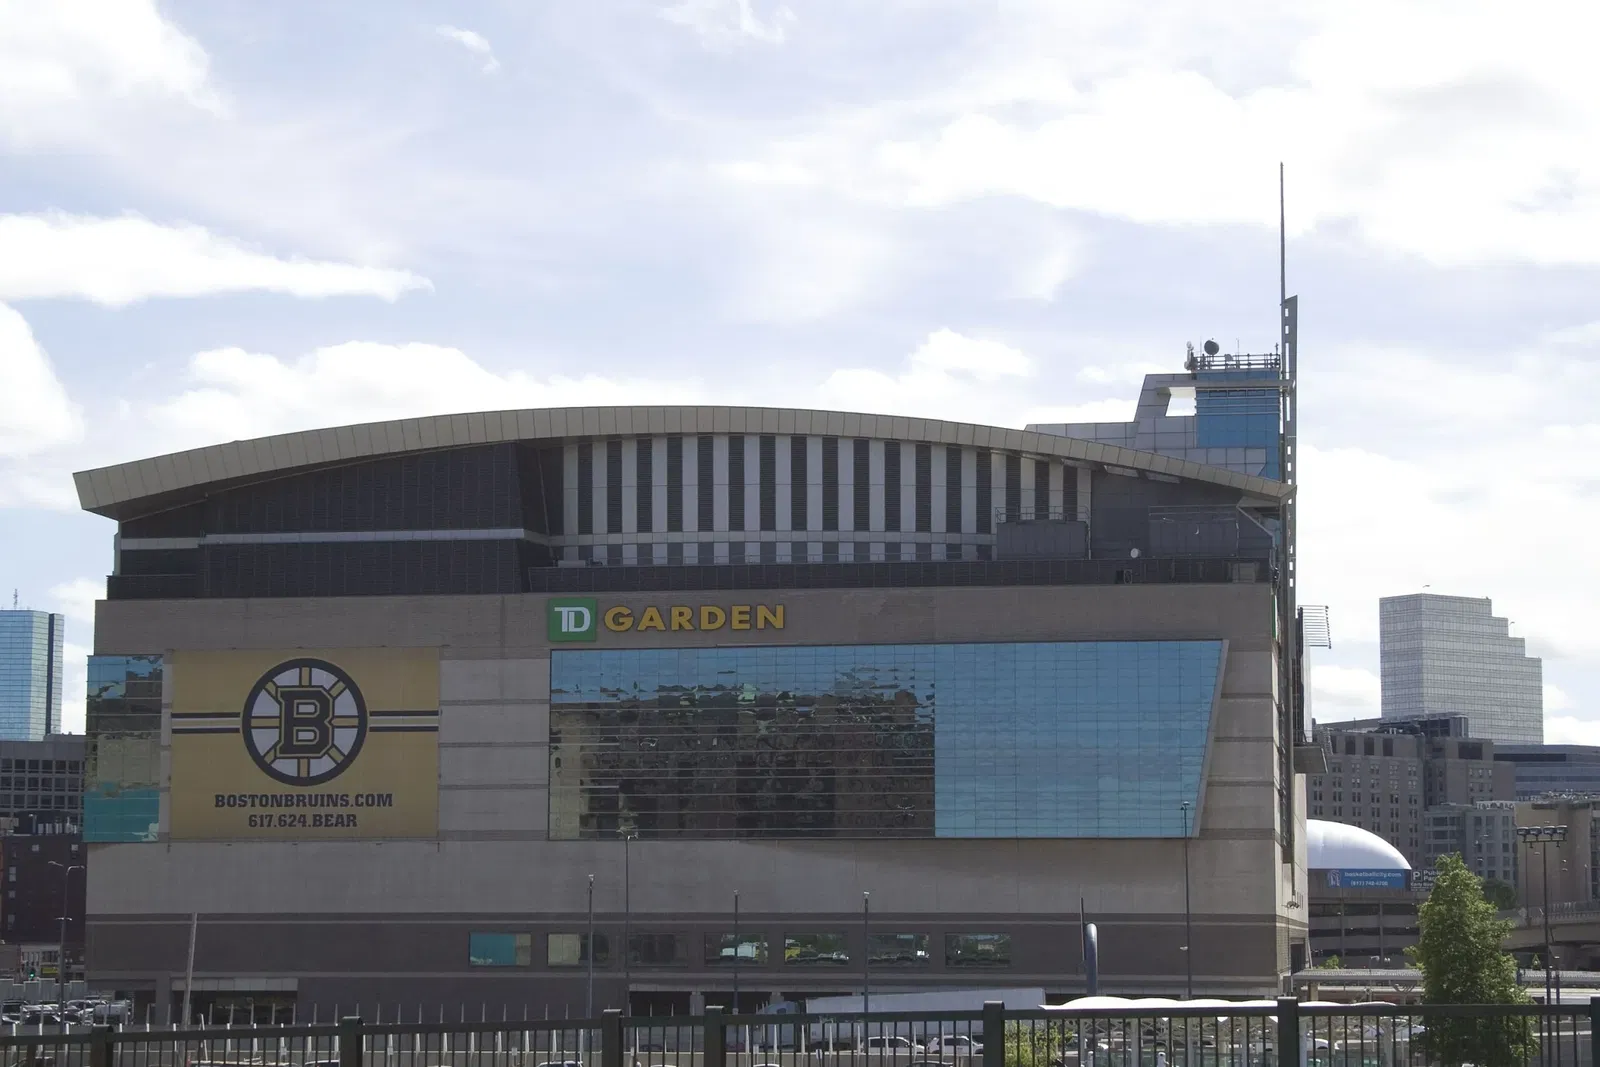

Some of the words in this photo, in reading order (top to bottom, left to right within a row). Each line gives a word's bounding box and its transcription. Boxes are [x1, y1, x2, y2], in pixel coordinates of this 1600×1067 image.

[554, 606, 591, 632] TD
[604, 604, 785, 632] GARDEN
[276, 686, 334, 758] B
[215, 794, 393, 808] BOSTONBRUINS.COM
[248, 814, 358, 828] 617.624.BEAR
[1412, 871, 1421, 881] P
